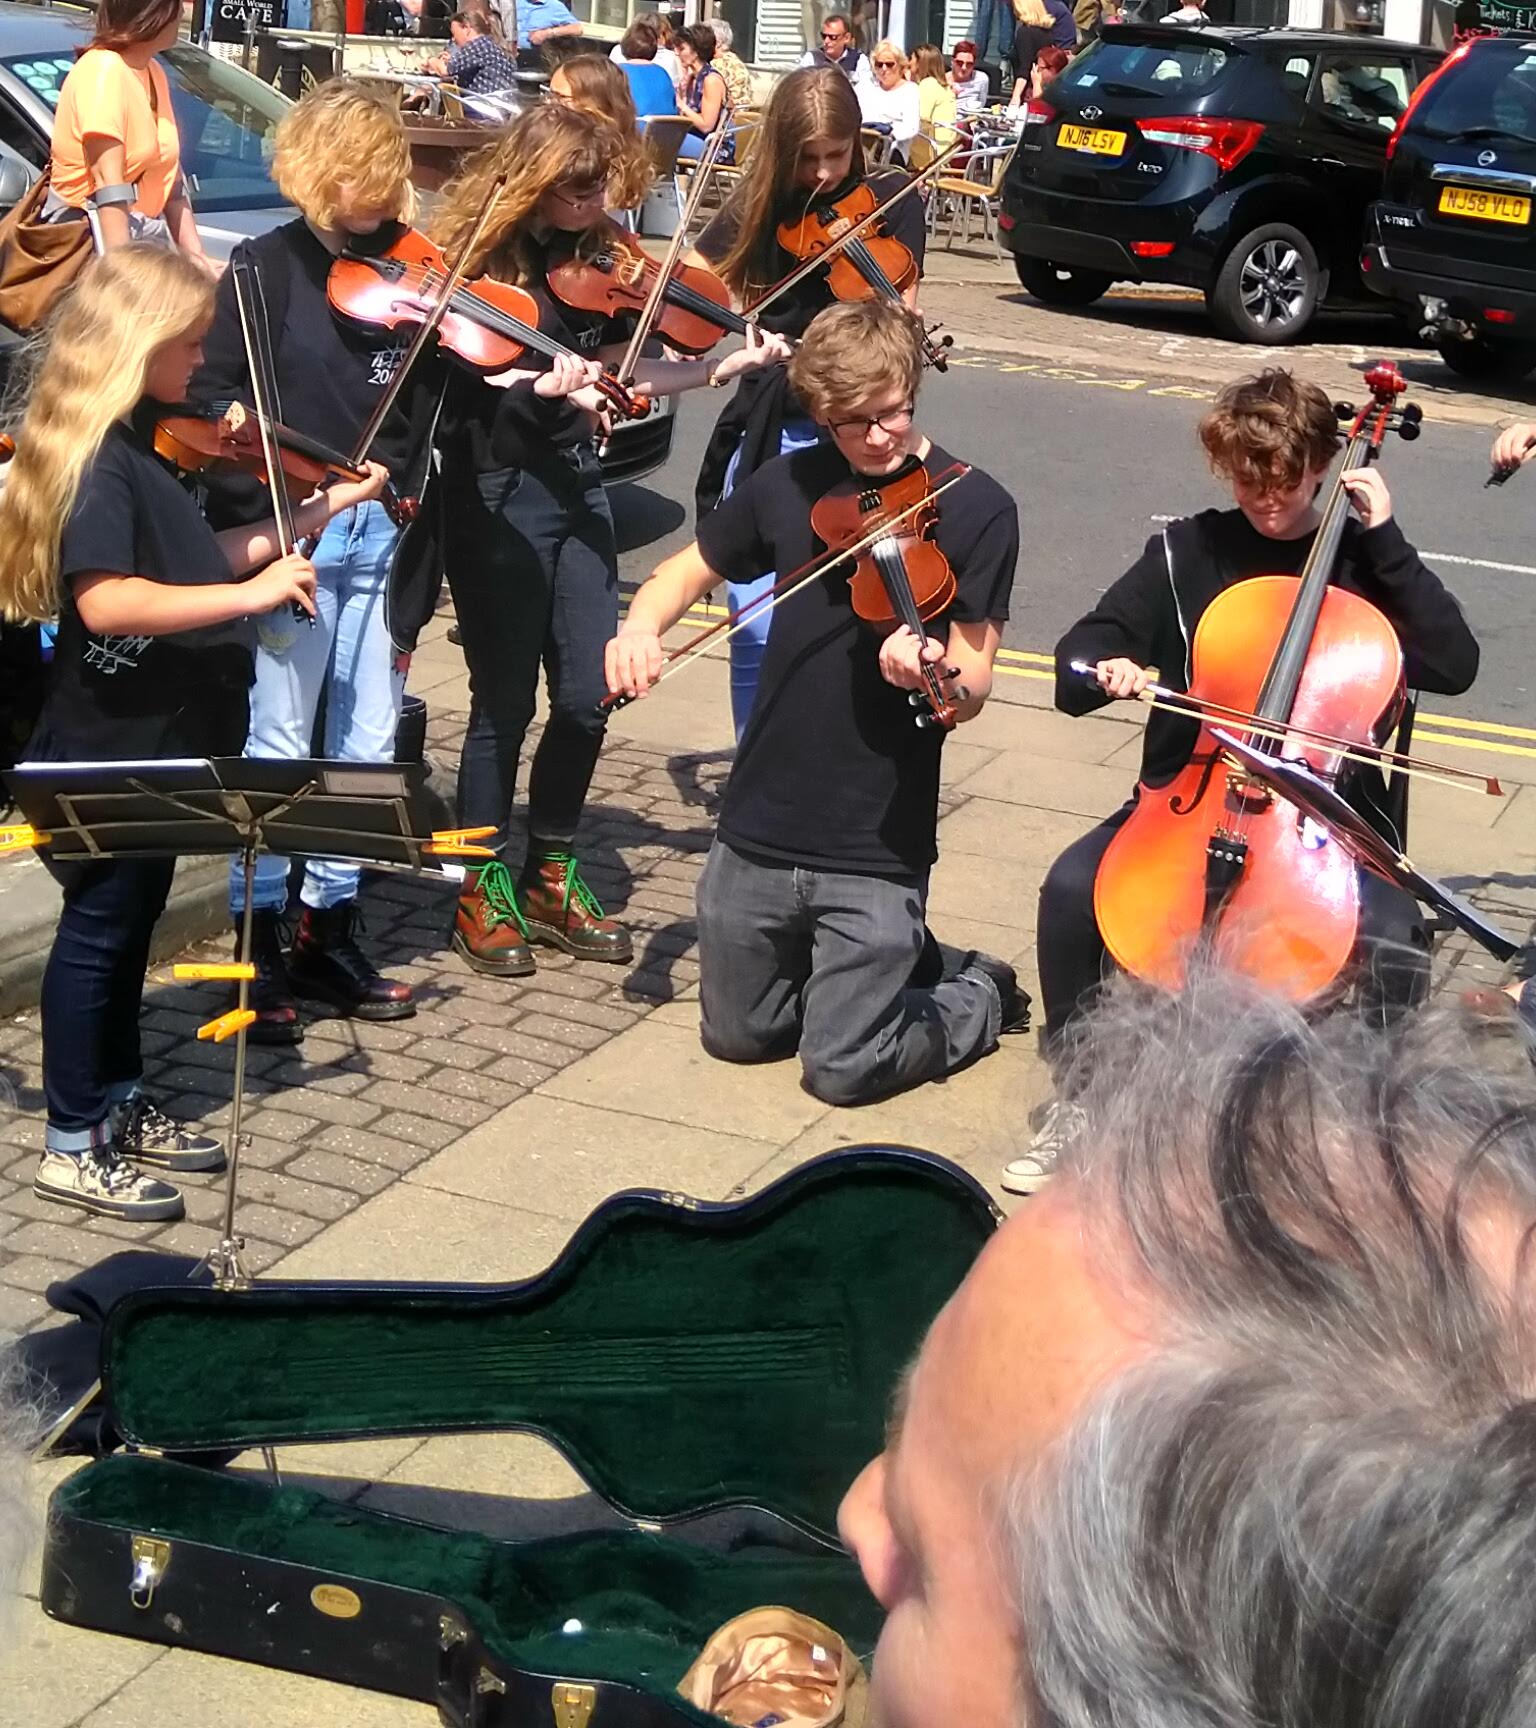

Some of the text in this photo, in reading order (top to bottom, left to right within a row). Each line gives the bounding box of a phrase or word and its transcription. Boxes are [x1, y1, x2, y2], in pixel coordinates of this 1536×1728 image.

[1064, 127, 1117, 150] NJ16 LSV
[1447, 190, 1524, 218] NJ58 VLO
